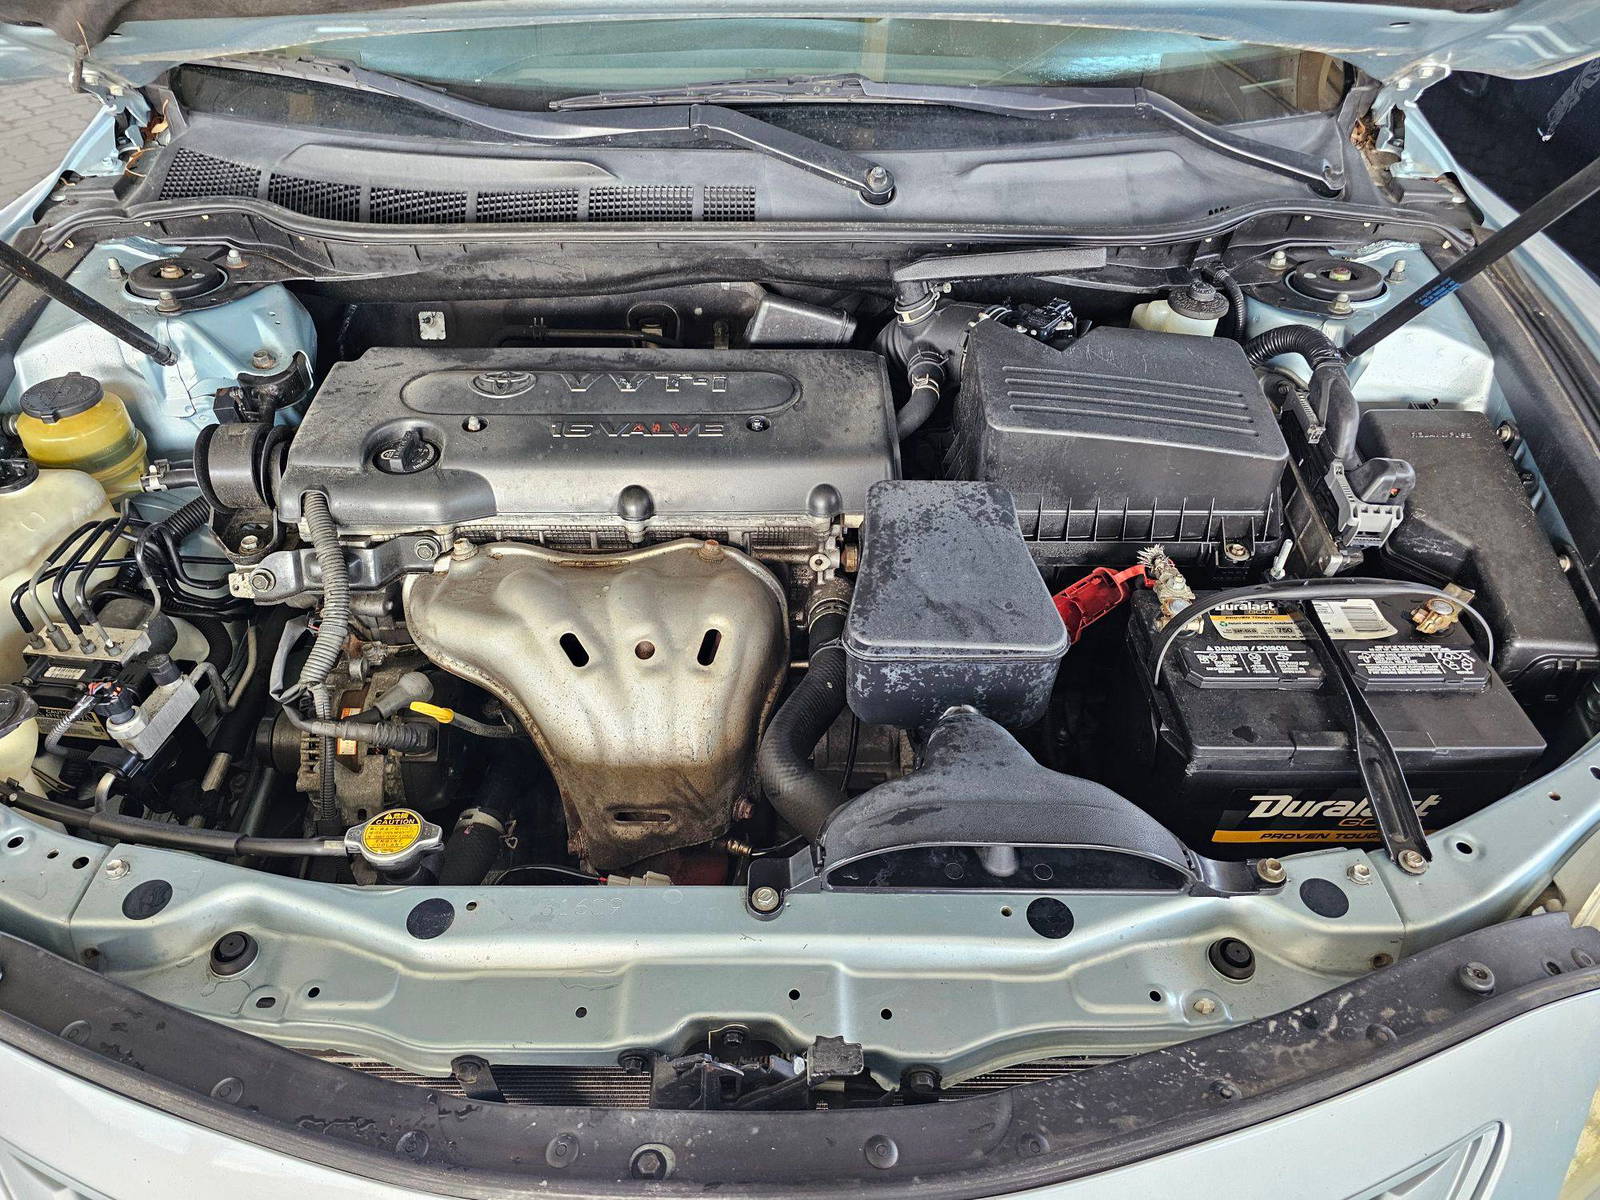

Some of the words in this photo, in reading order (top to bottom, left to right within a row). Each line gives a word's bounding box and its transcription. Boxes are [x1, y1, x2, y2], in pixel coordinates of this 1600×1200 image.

[599, 421, 724, 438] VALVE
[1276, 626, 1293, 634] 750
[1248, 794, 1441, 818] Duralt
